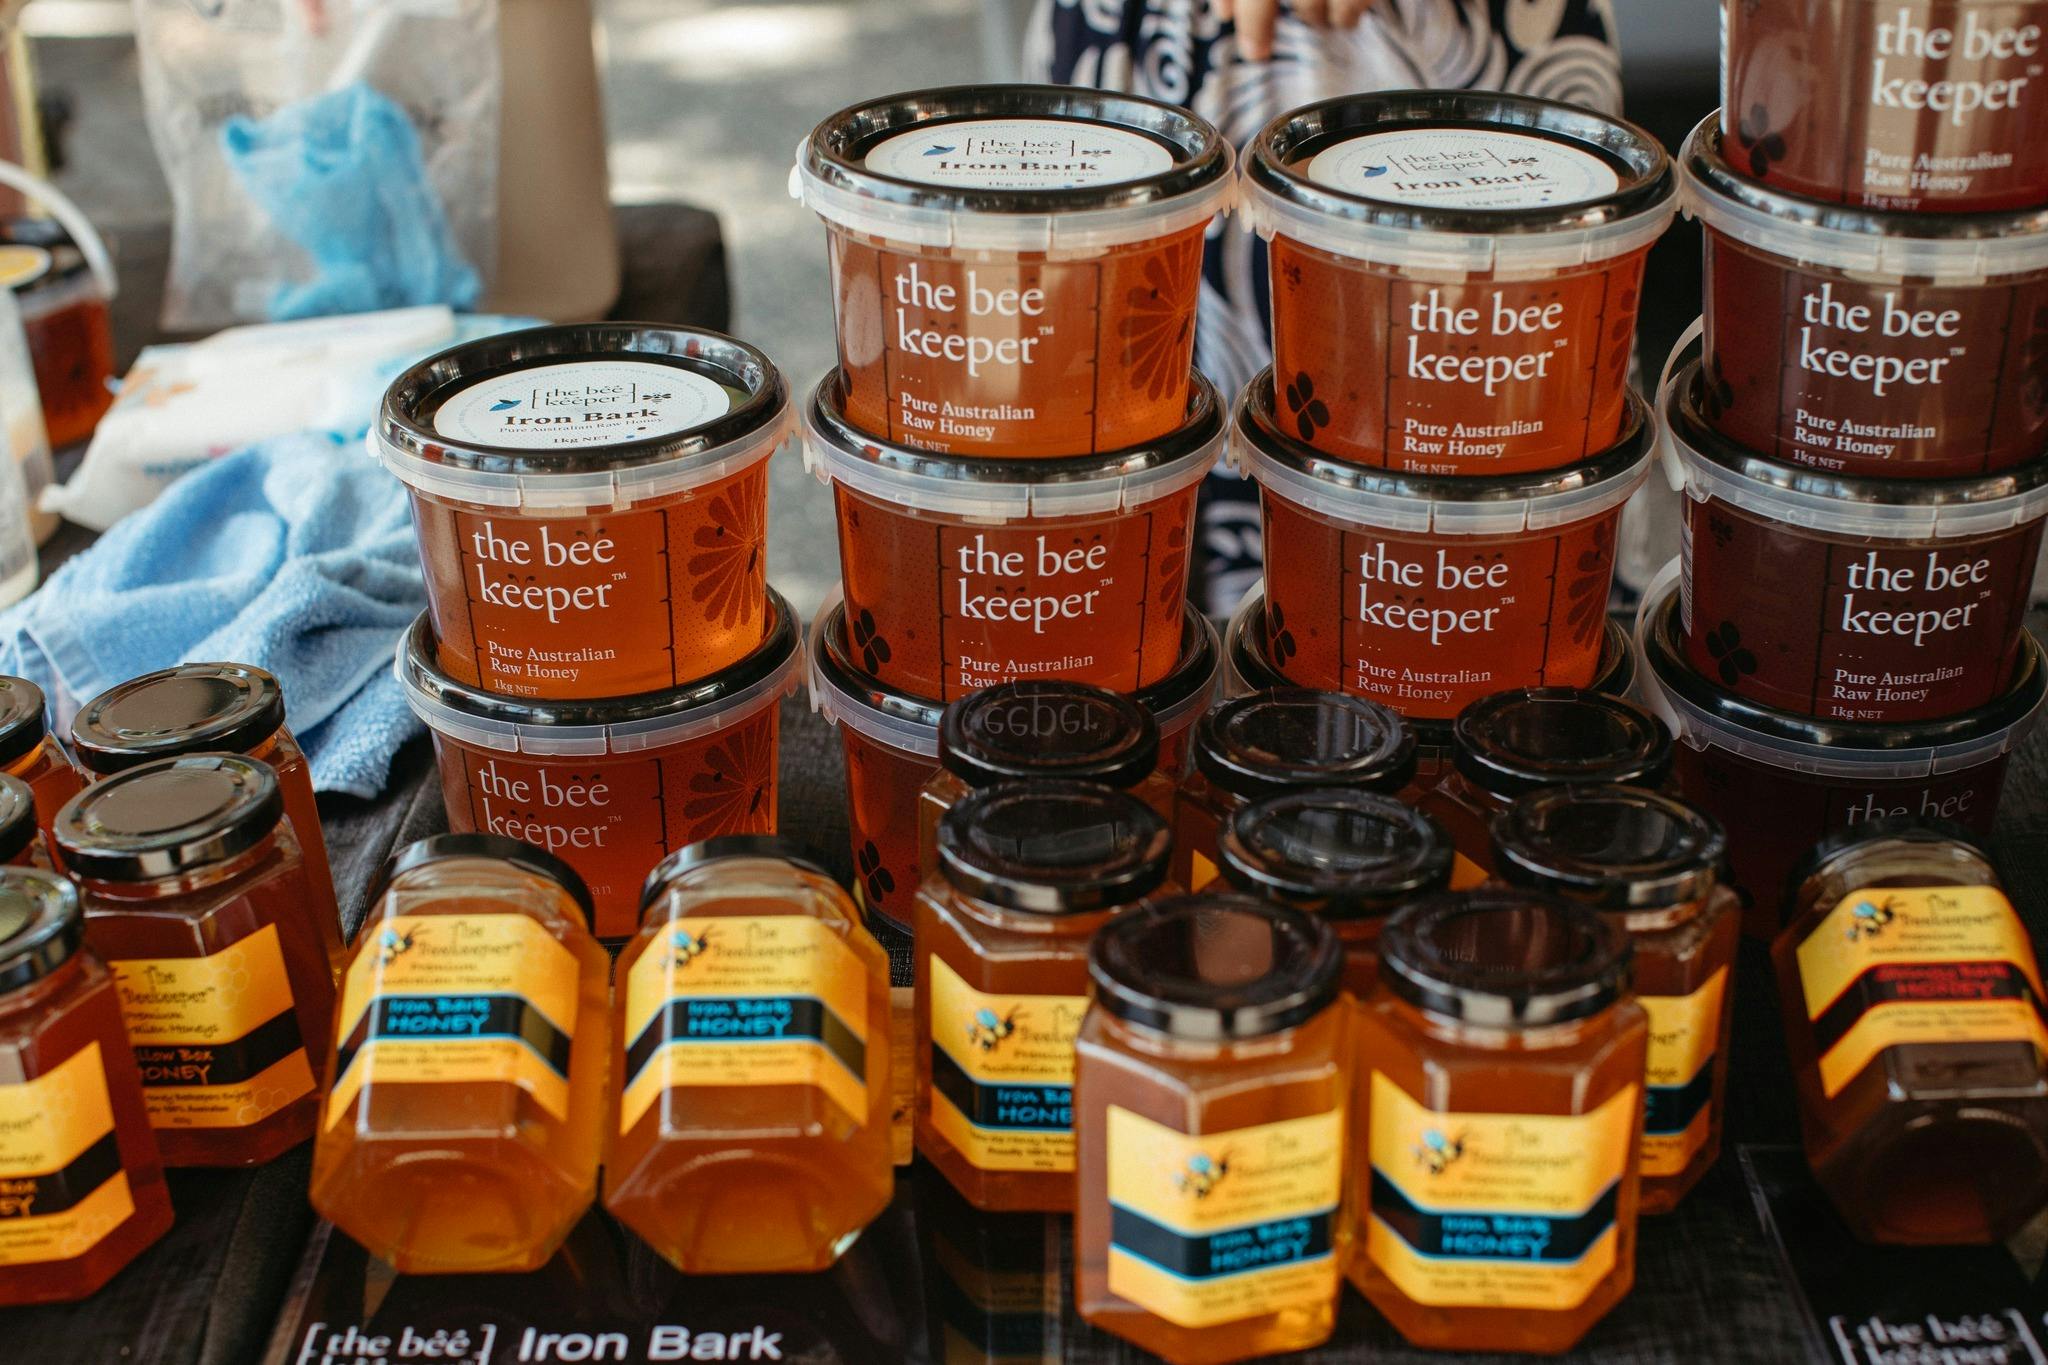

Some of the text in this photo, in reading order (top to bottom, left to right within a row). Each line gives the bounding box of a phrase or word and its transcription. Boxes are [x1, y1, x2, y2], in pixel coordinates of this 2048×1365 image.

[1876, 9, 1953, 60] the
[939, 161, 1098, 170] Iron Bark
[1403, 153, 1438, 163] the
[1866, 147, 2013, 171] Pure Australian
[1391, 171, 1551, 191] Iron Bark
[1864, 167, 1974, 194] Raw Honey
[895, 262, 1045, 316] the bee
[1409, 289, 1564, 336] the bee
[1803, 283, 1961, 337] the bee
[546, 387, 582, 397] the
[505, 408, 659, 426] Iron Bark
[901, 392, 1035, 420] Pure Australian
[530, 424, 593, 433] Australian
[597, 421, 622, 429] Raw
[625, 418, 664, 426] Honey
[902, 410, 995, 440] Raw Honey
[1404, 418, 1543, 438] Pure Australian
[1796, 408, 1936, 439] Pure Australian
[903, 433, 950, 452] 1kg NET
[1403, 435, 1506, 457] Raw Honey
[1795, 426, 1895, 460] Raw Honey
[1403, 459, 1458, 474] 1kg NET
[1793, 449, 1845, 470] 1kg NET
[472, 521, 615, 568] the bee
[958, 534, 1107, 577] the bee
[1360, 543, 1509, 590] the bee
[1847, 551, 1990, 592] the bee
[488, 640, 616, 663] Pure Australian
[491, 657, 579, 682] Raw Honey
[959, 654, 1094, 674] Pure Australian
[1358, 659, 1491, 684] Pure Australian
[494, 678, 539, 696] 1kg NET
[960, 672, 997, 689] Raw
[1834, 666, 1963, 686] Pure Australian
[1358, 675, 1453, 703] Raw Honey
[1833, 684, 1929, 703] Raw Honey
[1830, 705, 1883, 720] 1kg NET
[478, 760, 610, 807] the bee
[387, 1014, 490, 1036] HONEY
[688, 1016, 792, 1037] HONEY
[998, 1105, 1074, 1125] HONE
[326, 1325, 392, 1357] the
[517, 1324, 784, 1363] Iron Bark
